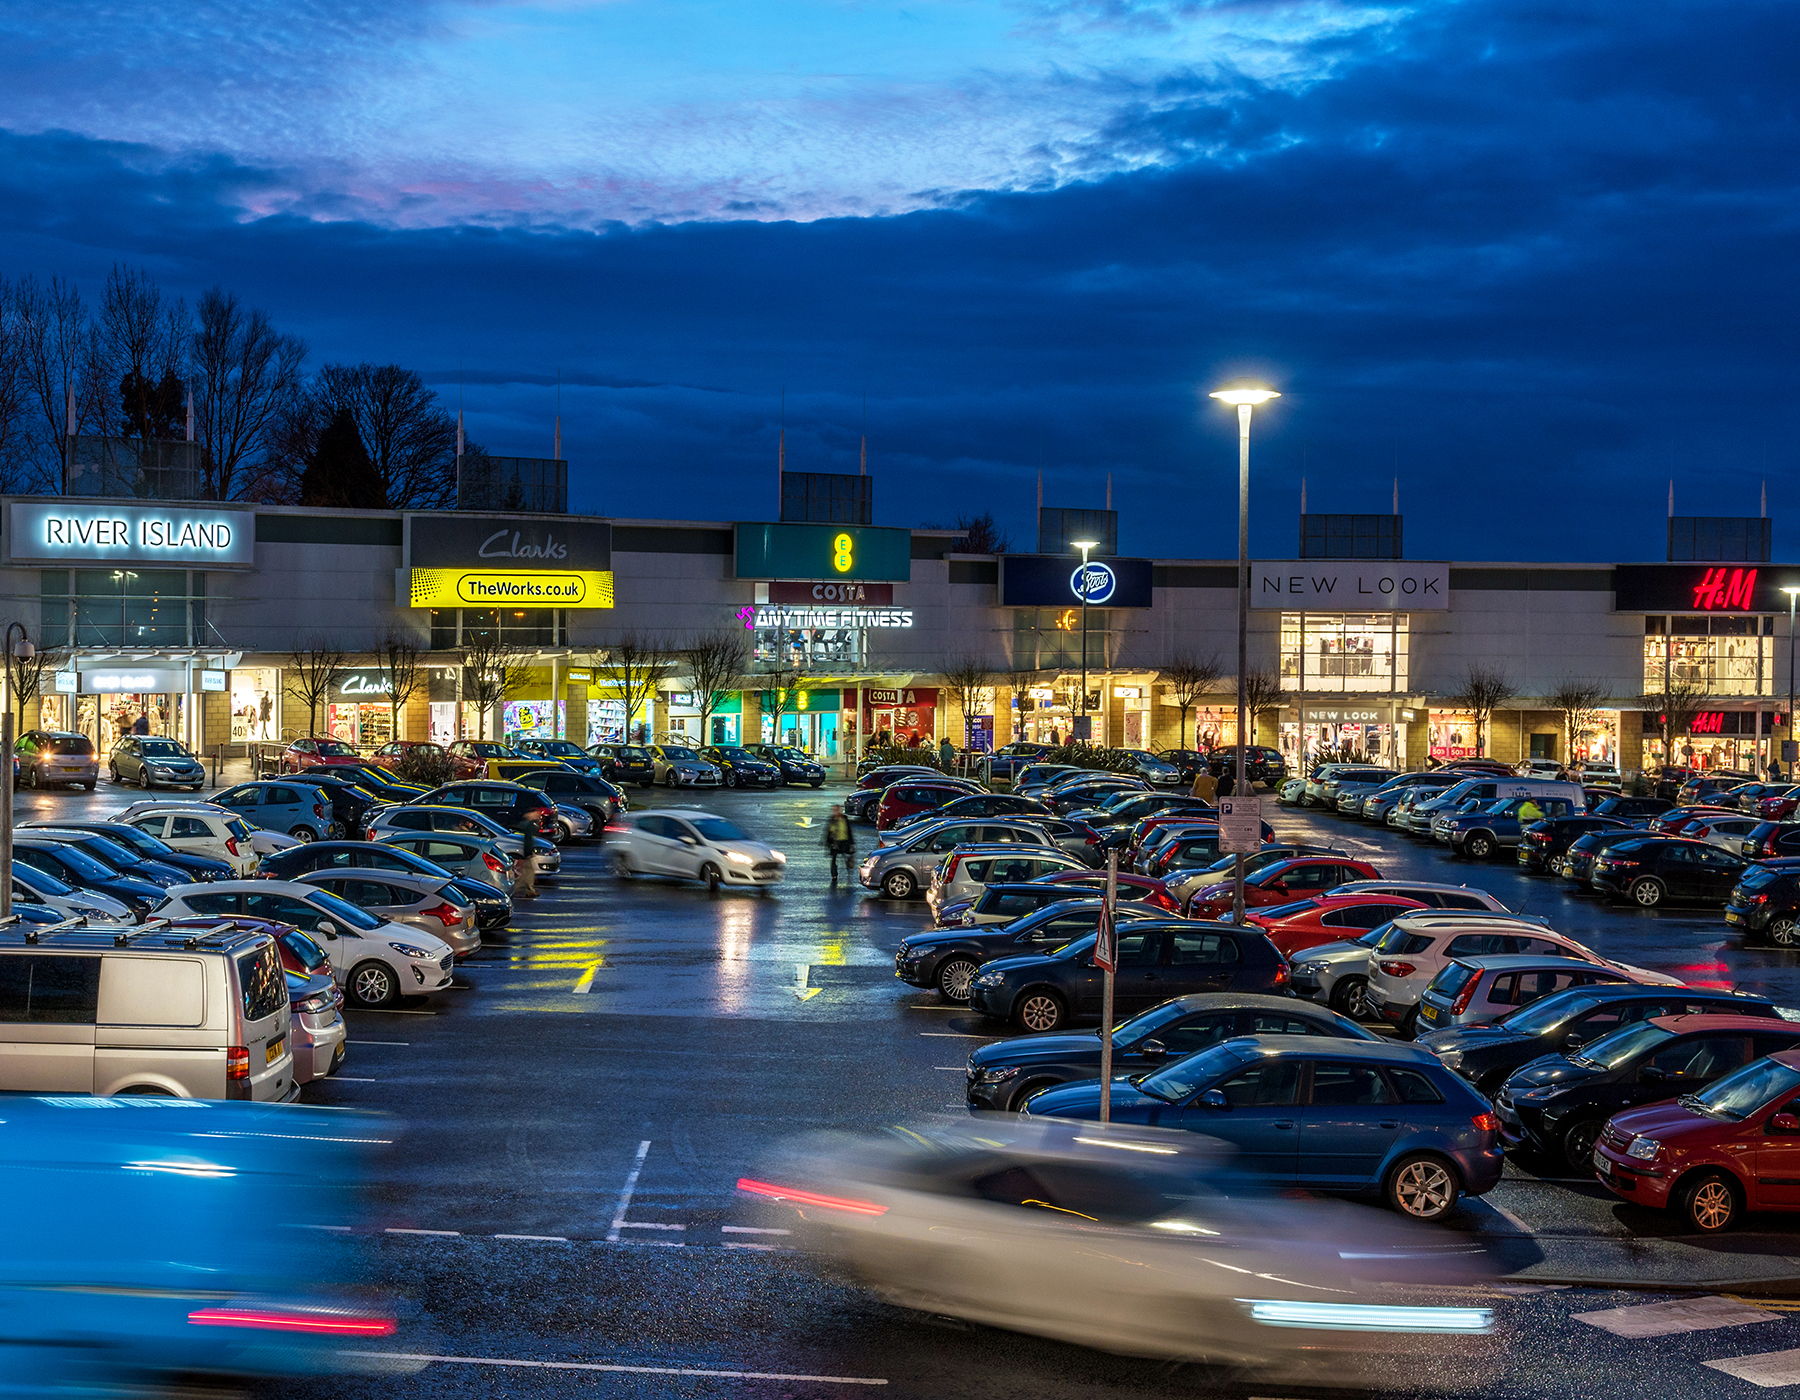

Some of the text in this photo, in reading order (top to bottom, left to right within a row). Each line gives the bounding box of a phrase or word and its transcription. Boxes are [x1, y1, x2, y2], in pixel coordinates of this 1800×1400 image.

[47, 519, 231, 548] RIVER ISLAND
[478, 529, 568, 559] Clarks
[468, 581, 579, 596] TheWorks.co.uk
[1077, 570, 1109, 593] Boots
[1263, 576, 1440, 594] NEW LOOK
[1693, 567, 1757, 610] H&M
[812, 584, 866, 602] COSTA
[755, 610, 913, 628] ANYTIME FITNESS
[872, 691, 896, 701] COSTA
[1309, 711, 1378, 721] NEW LOOK
[1691, 711, 1724, 733] H&M
[1223, 804, 1231, 814] P
